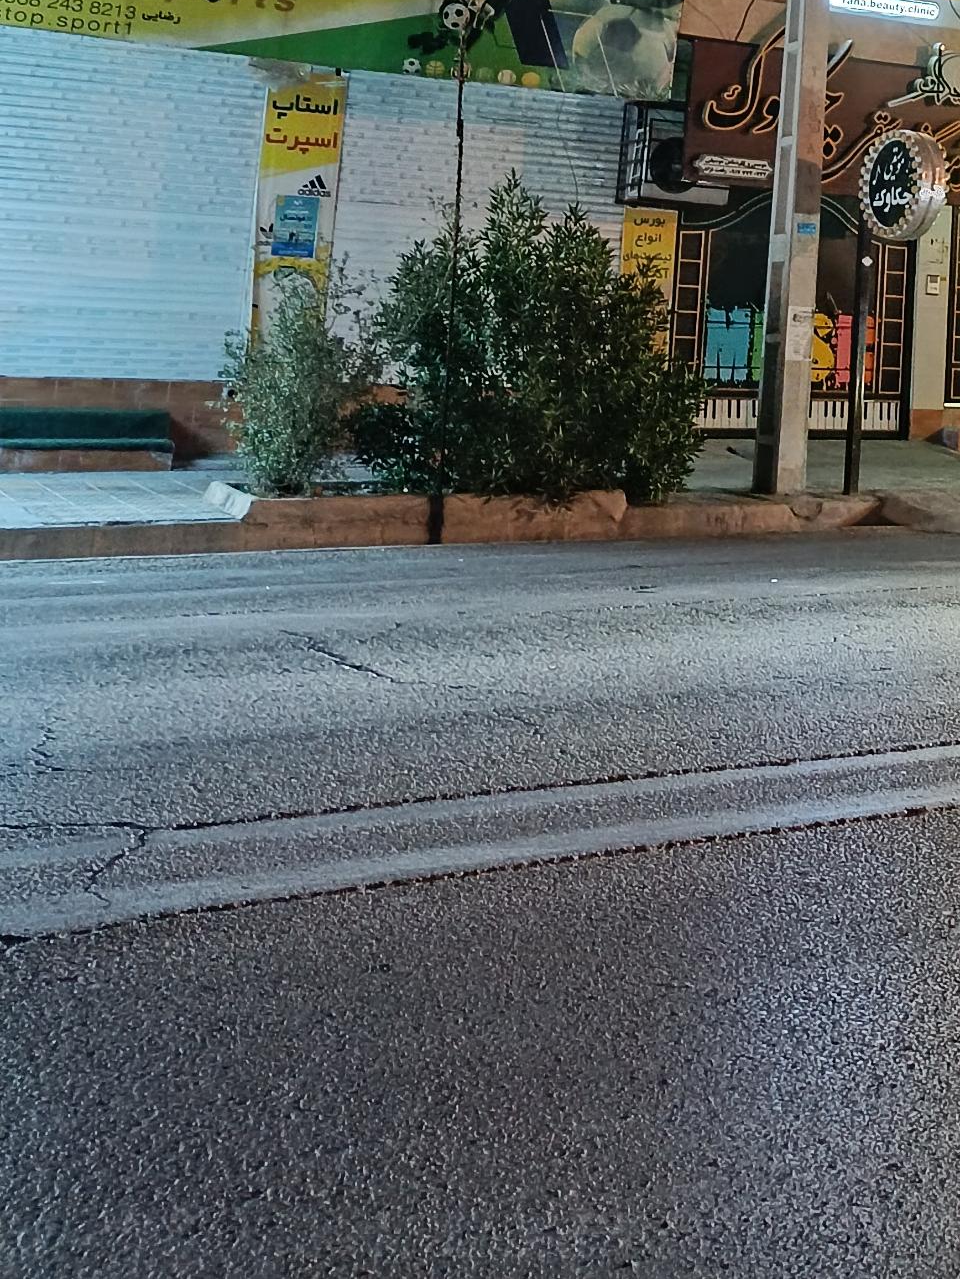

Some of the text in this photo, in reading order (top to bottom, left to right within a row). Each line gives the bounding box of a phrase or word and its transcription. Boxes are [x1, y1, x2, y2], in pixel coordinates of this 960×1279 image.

[89, 1, 136, 20] 8213
[142, 10, 182, 24] رضایی
[272, 94, 339, 119] استاپ
[265, 128, 339, 154] اسپرت
[298, 188, 331, 198] adidas
[633, 215, 666, 228] بورس
[634, 232, 662, 247] انواع
